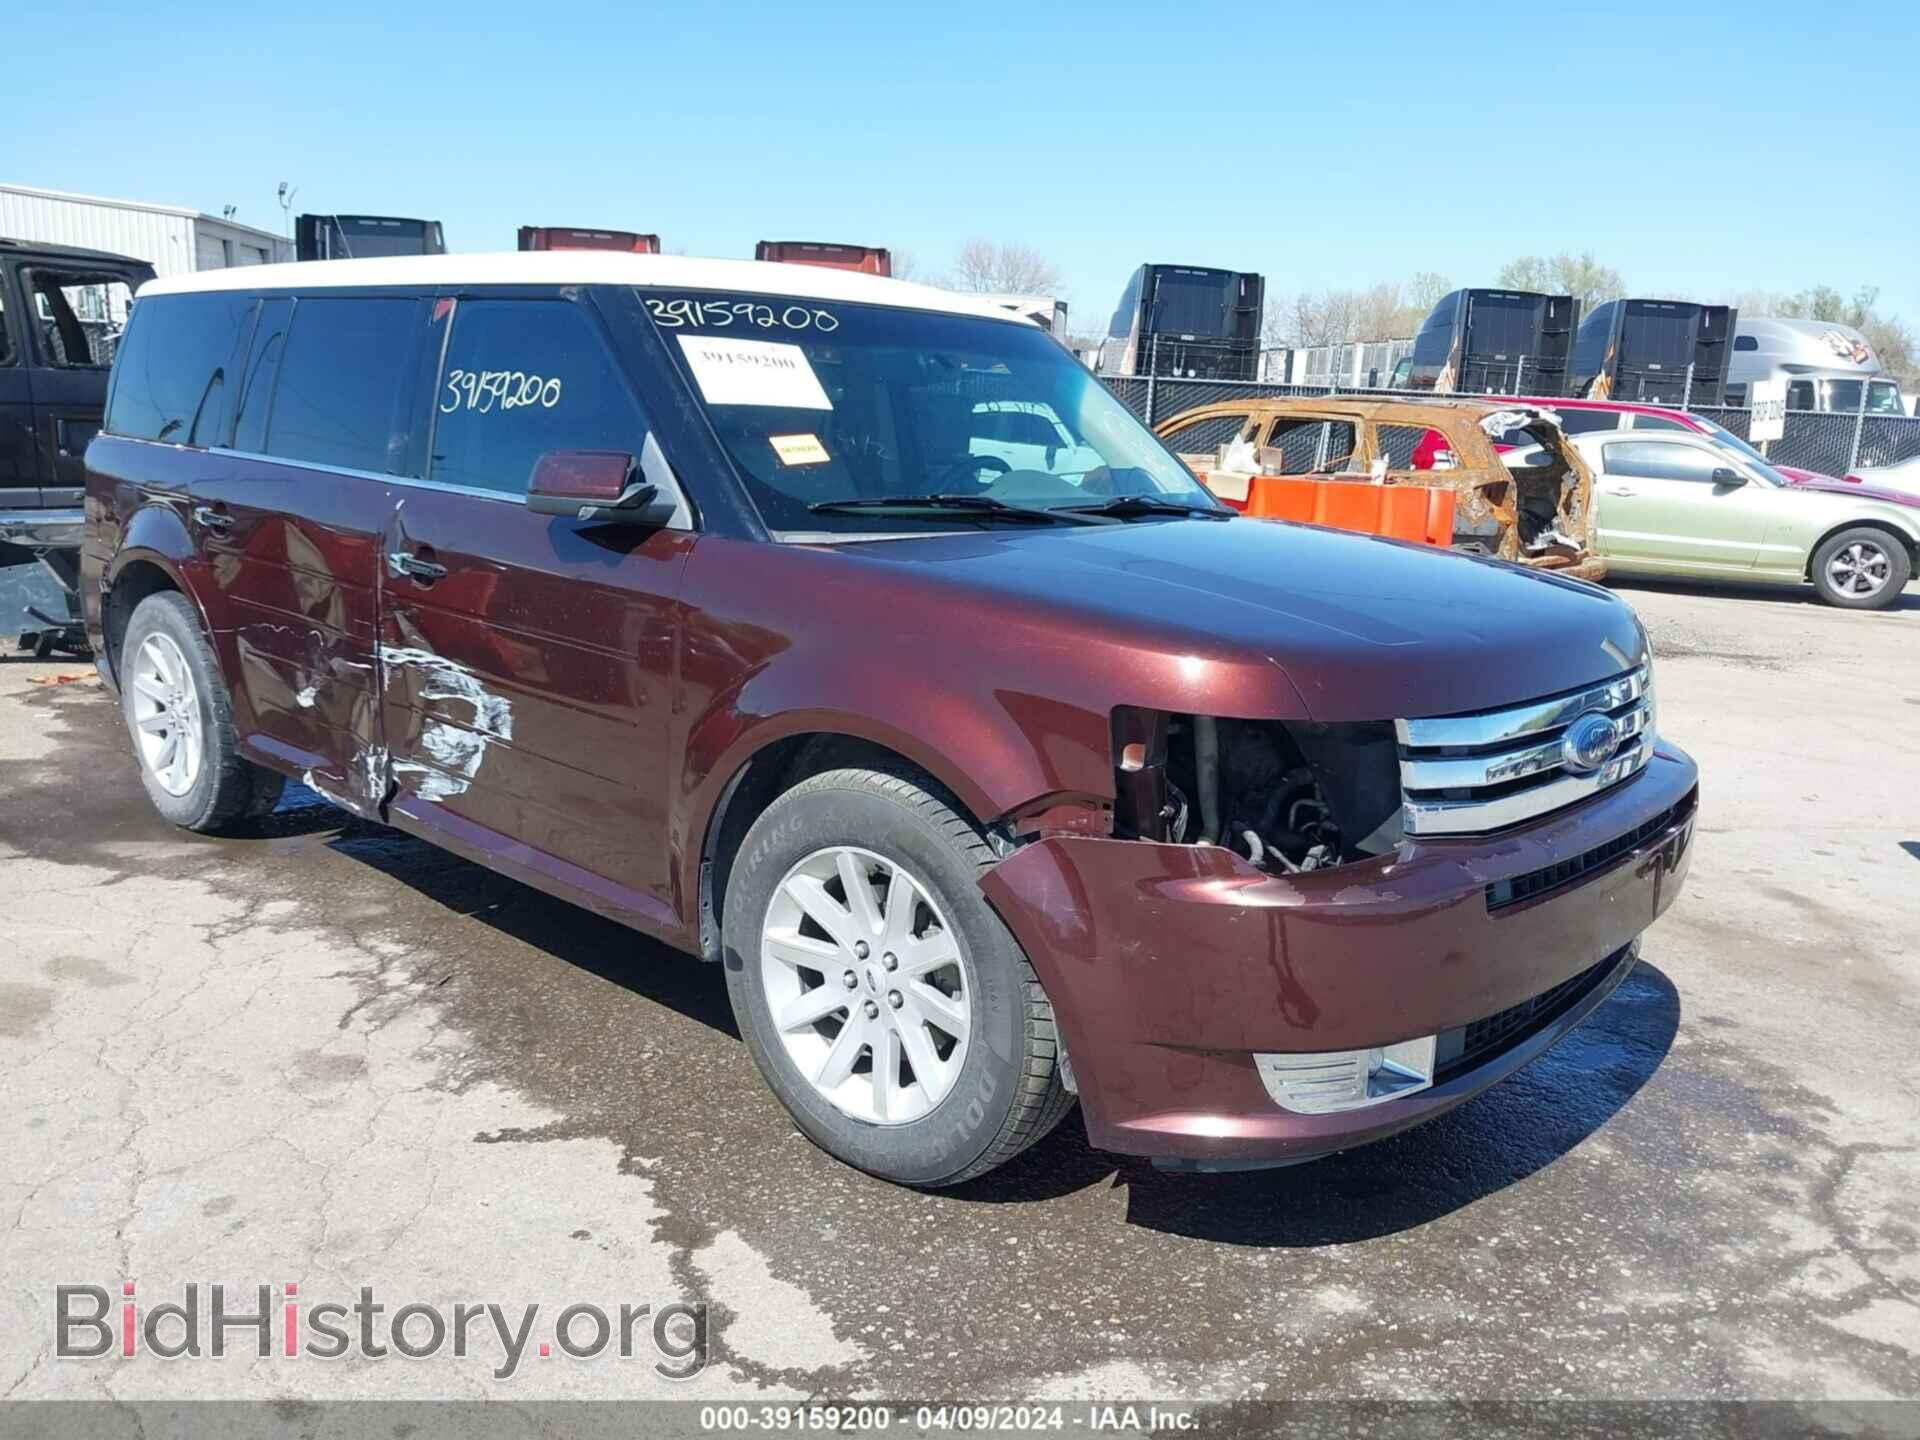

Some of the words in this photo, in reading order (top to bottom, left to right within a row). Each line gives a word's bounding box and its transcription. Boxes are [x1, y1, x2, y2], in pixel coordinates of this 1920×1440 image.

[645, 299, 839, 332] 39159200
[700, 350, 796, 370] 39159200
[440, 369, 561, 413] 39159200
